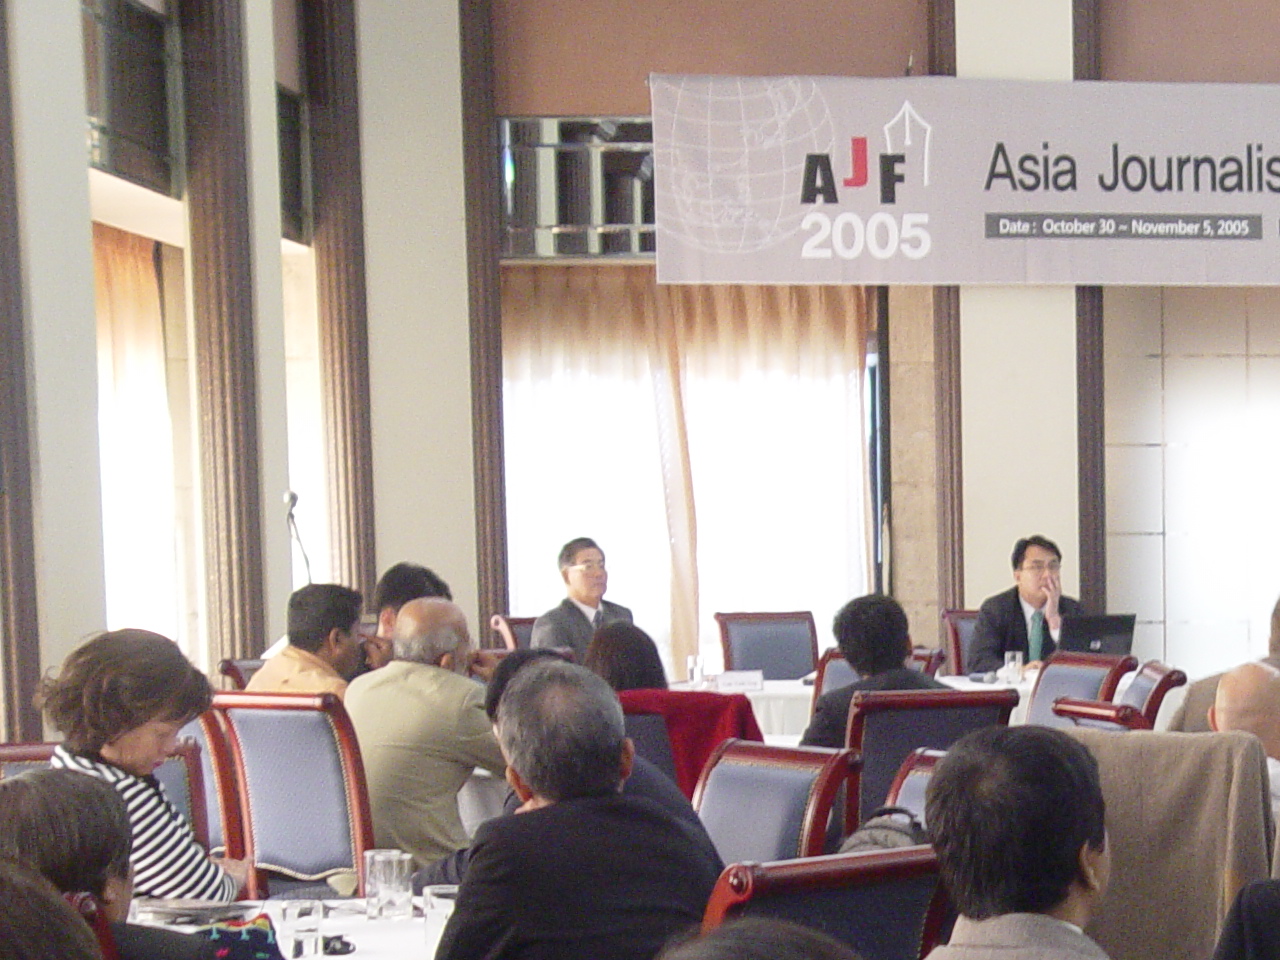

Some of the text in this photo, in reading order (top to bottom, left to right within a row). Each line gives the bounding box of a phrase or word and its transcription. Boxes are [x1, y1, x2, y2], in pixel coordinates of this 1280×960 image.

[801, 136, 906, 205] AJF
[984, 141, 1077, 192] Asia
[801, 212, 932, 260] 2005
[1042, 218, 1096, 234] October
[1099, 219, 1116, 235] 30
[1132, 219, 1200, 235] November
[1203, 219, 1214, 236] 5,
[1217, 220, 1249, 235] 2005
